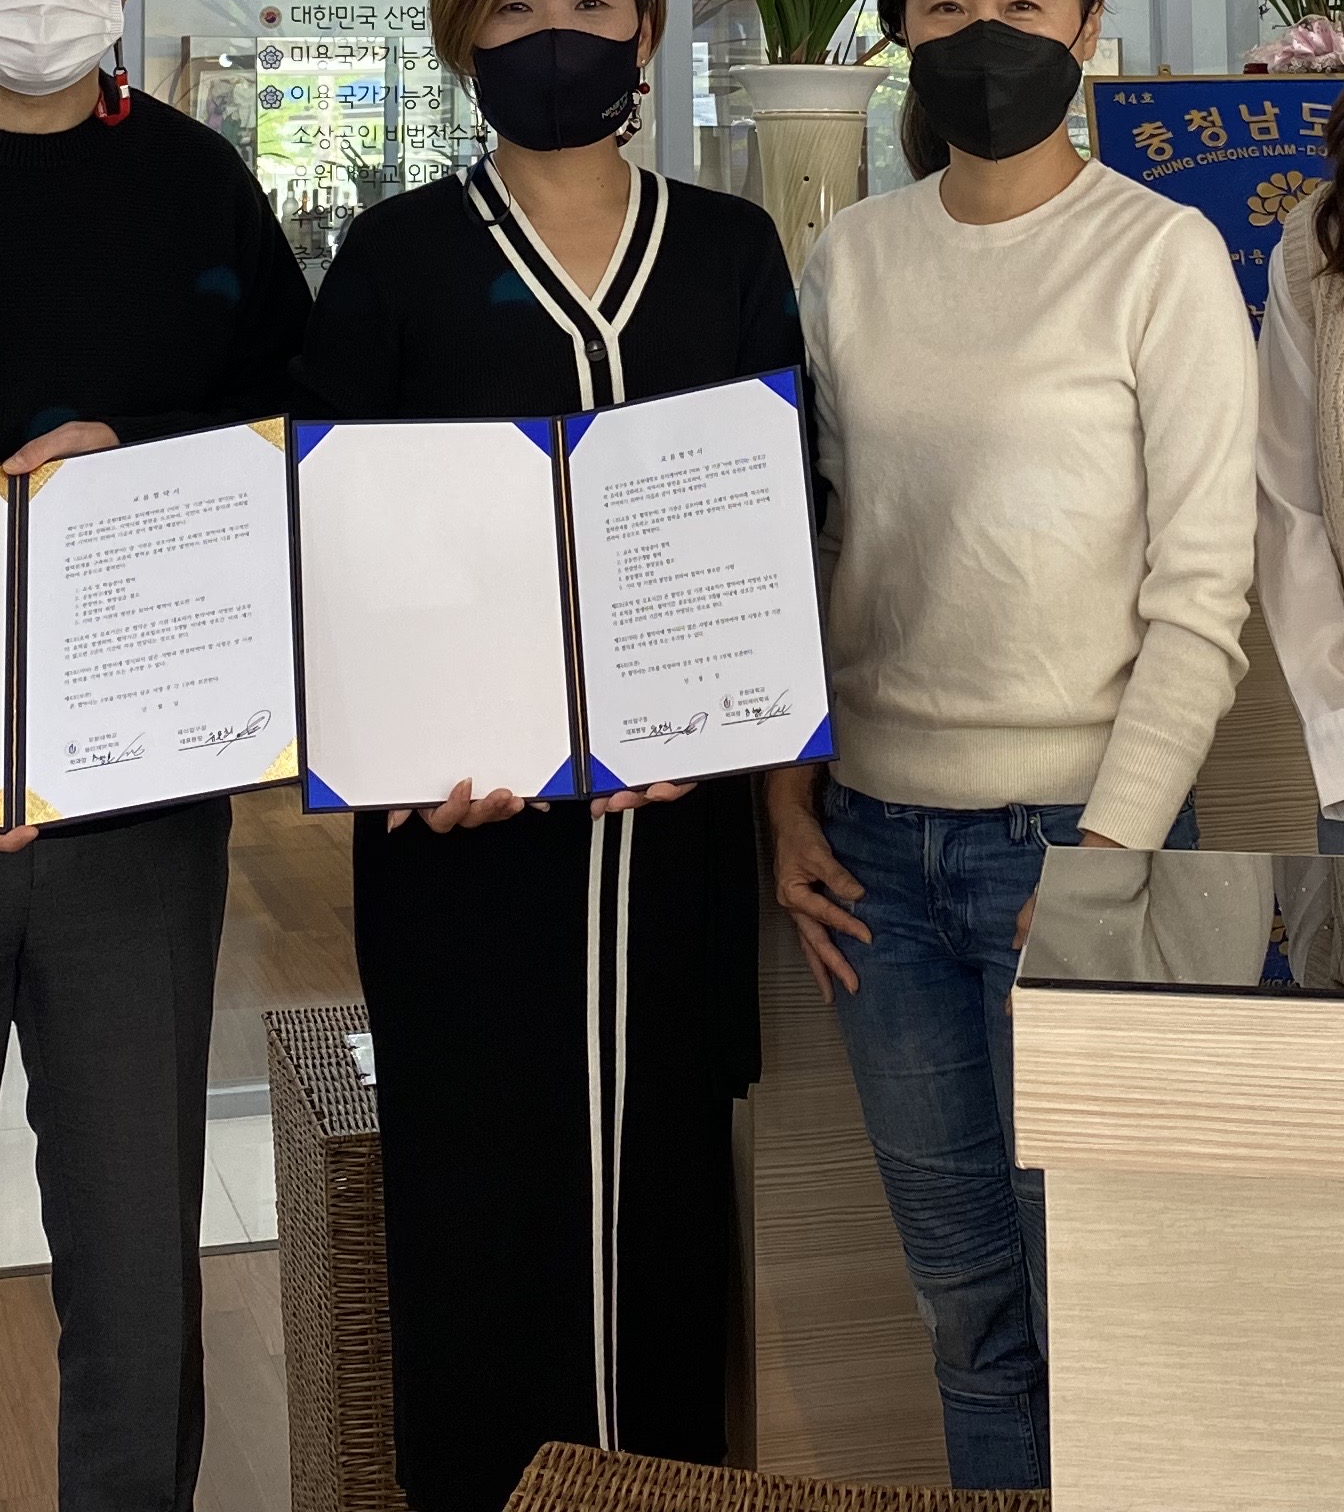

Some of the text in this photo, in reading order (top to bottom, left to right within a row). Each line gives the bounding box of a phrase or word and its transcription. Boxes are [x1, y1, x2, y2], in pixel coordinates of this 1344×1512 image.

[290, 4, 378, 31] 대한민국
[290, 45, 438, 71] 미용국가기능장
[290, 84, 444, 110] 이용국가기능장
[291, 125, 378, 150] 소상공인
[1142, 157, 1195, 182] CHUNG
[1199, 146, 1260, 166] CHEONG
